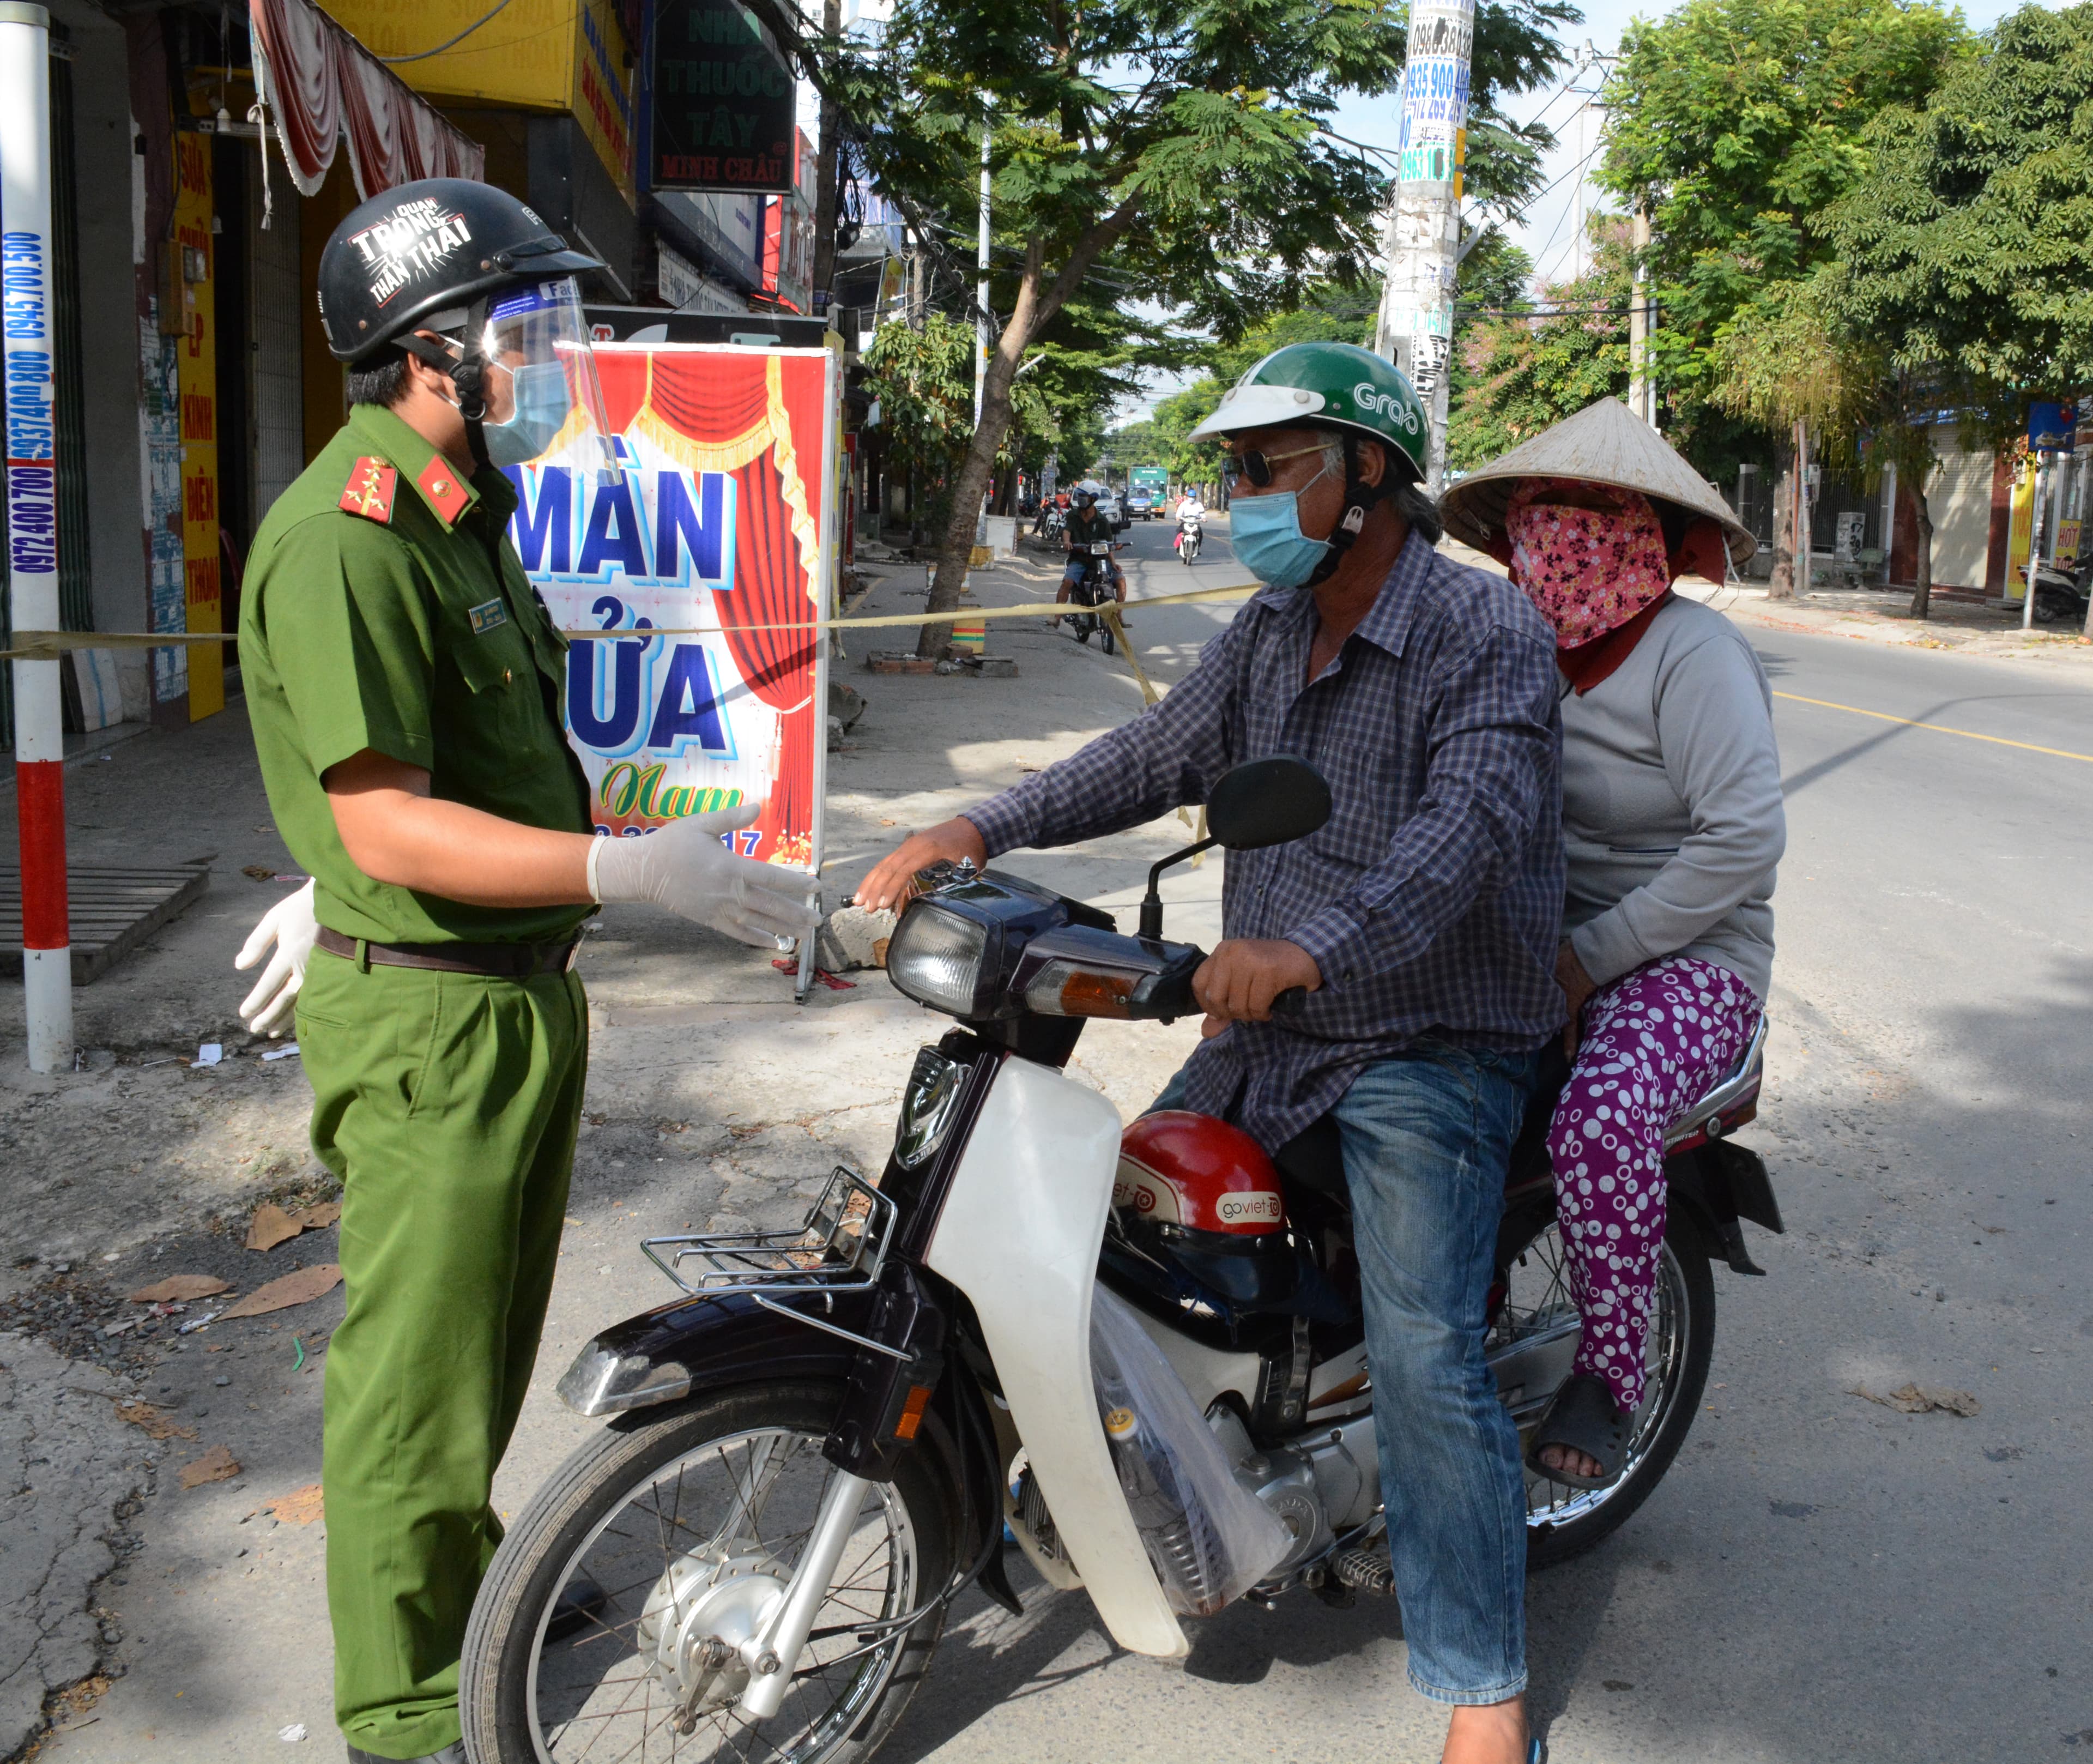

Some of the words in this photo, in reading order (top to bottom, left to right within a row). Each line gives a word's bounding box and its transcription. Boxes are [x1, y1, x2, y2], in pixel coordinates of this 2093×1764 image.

[662, 51, 786, 98] THUỐC
[687, 104, 759, 148] TÂY
[662, 155, 719, 182] MINH
[724, 153, 783, 183] CHÂU
[397, 200, 438, 217] QUAN
[407, 217, 472, 269] THÁI
[3, 232, 45, 339] 0945.700.500
[184, 384, 213, 442] KÍNH
[1353, 382, 1418, 436] Grab
[11, 468, 56, 573] 0972.400.700
[566, 596, 735, 758] ỬA
[599, 761, 745, 819] Nam
[1665, 1129, 1699, 1145] STARTER
[1223, 1199, 1267, 1219] goviet
